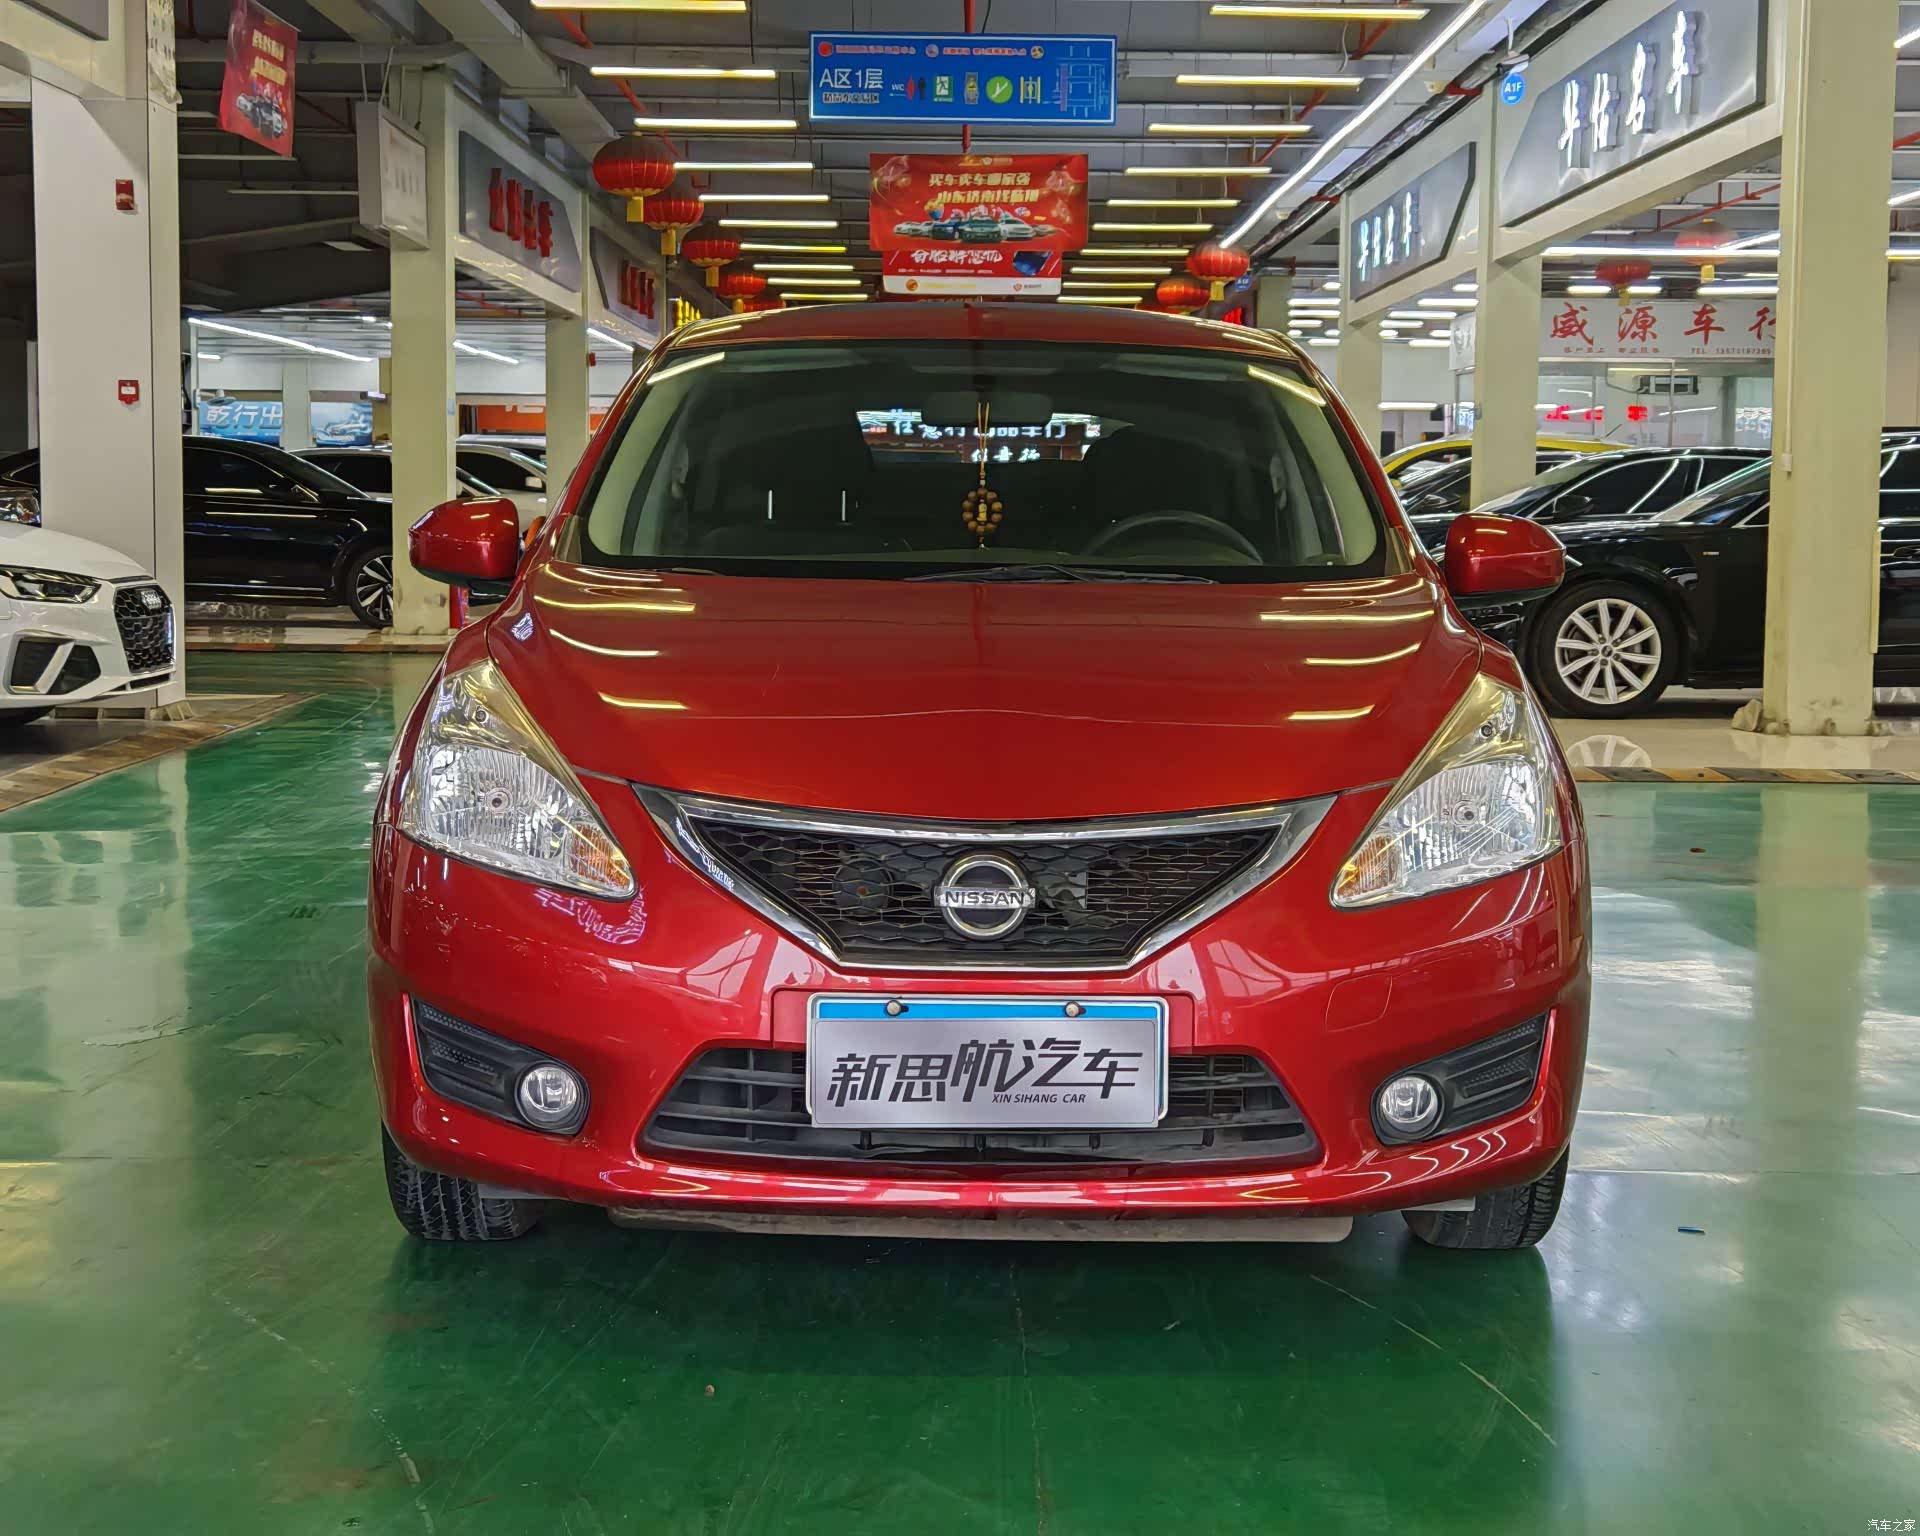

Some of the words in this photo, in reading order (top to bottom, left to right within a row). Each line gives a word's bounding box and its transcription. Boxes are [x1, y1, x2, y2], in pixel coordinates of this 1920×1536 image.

[819, 68, 884, 89] A区1层
[891, 83, 905, 91] WC
[1504, 82, 1522, 92] A1F
[945, 890, 1025, 906] NISSAN
[826, 1037, 1144, 1108] 新思航汽车
[991, 1093, 1012, 1104] XIN
[1013, 1093, 1058, 1104] SIHANG
[1062, 1093, 1087, 1104] CAR
